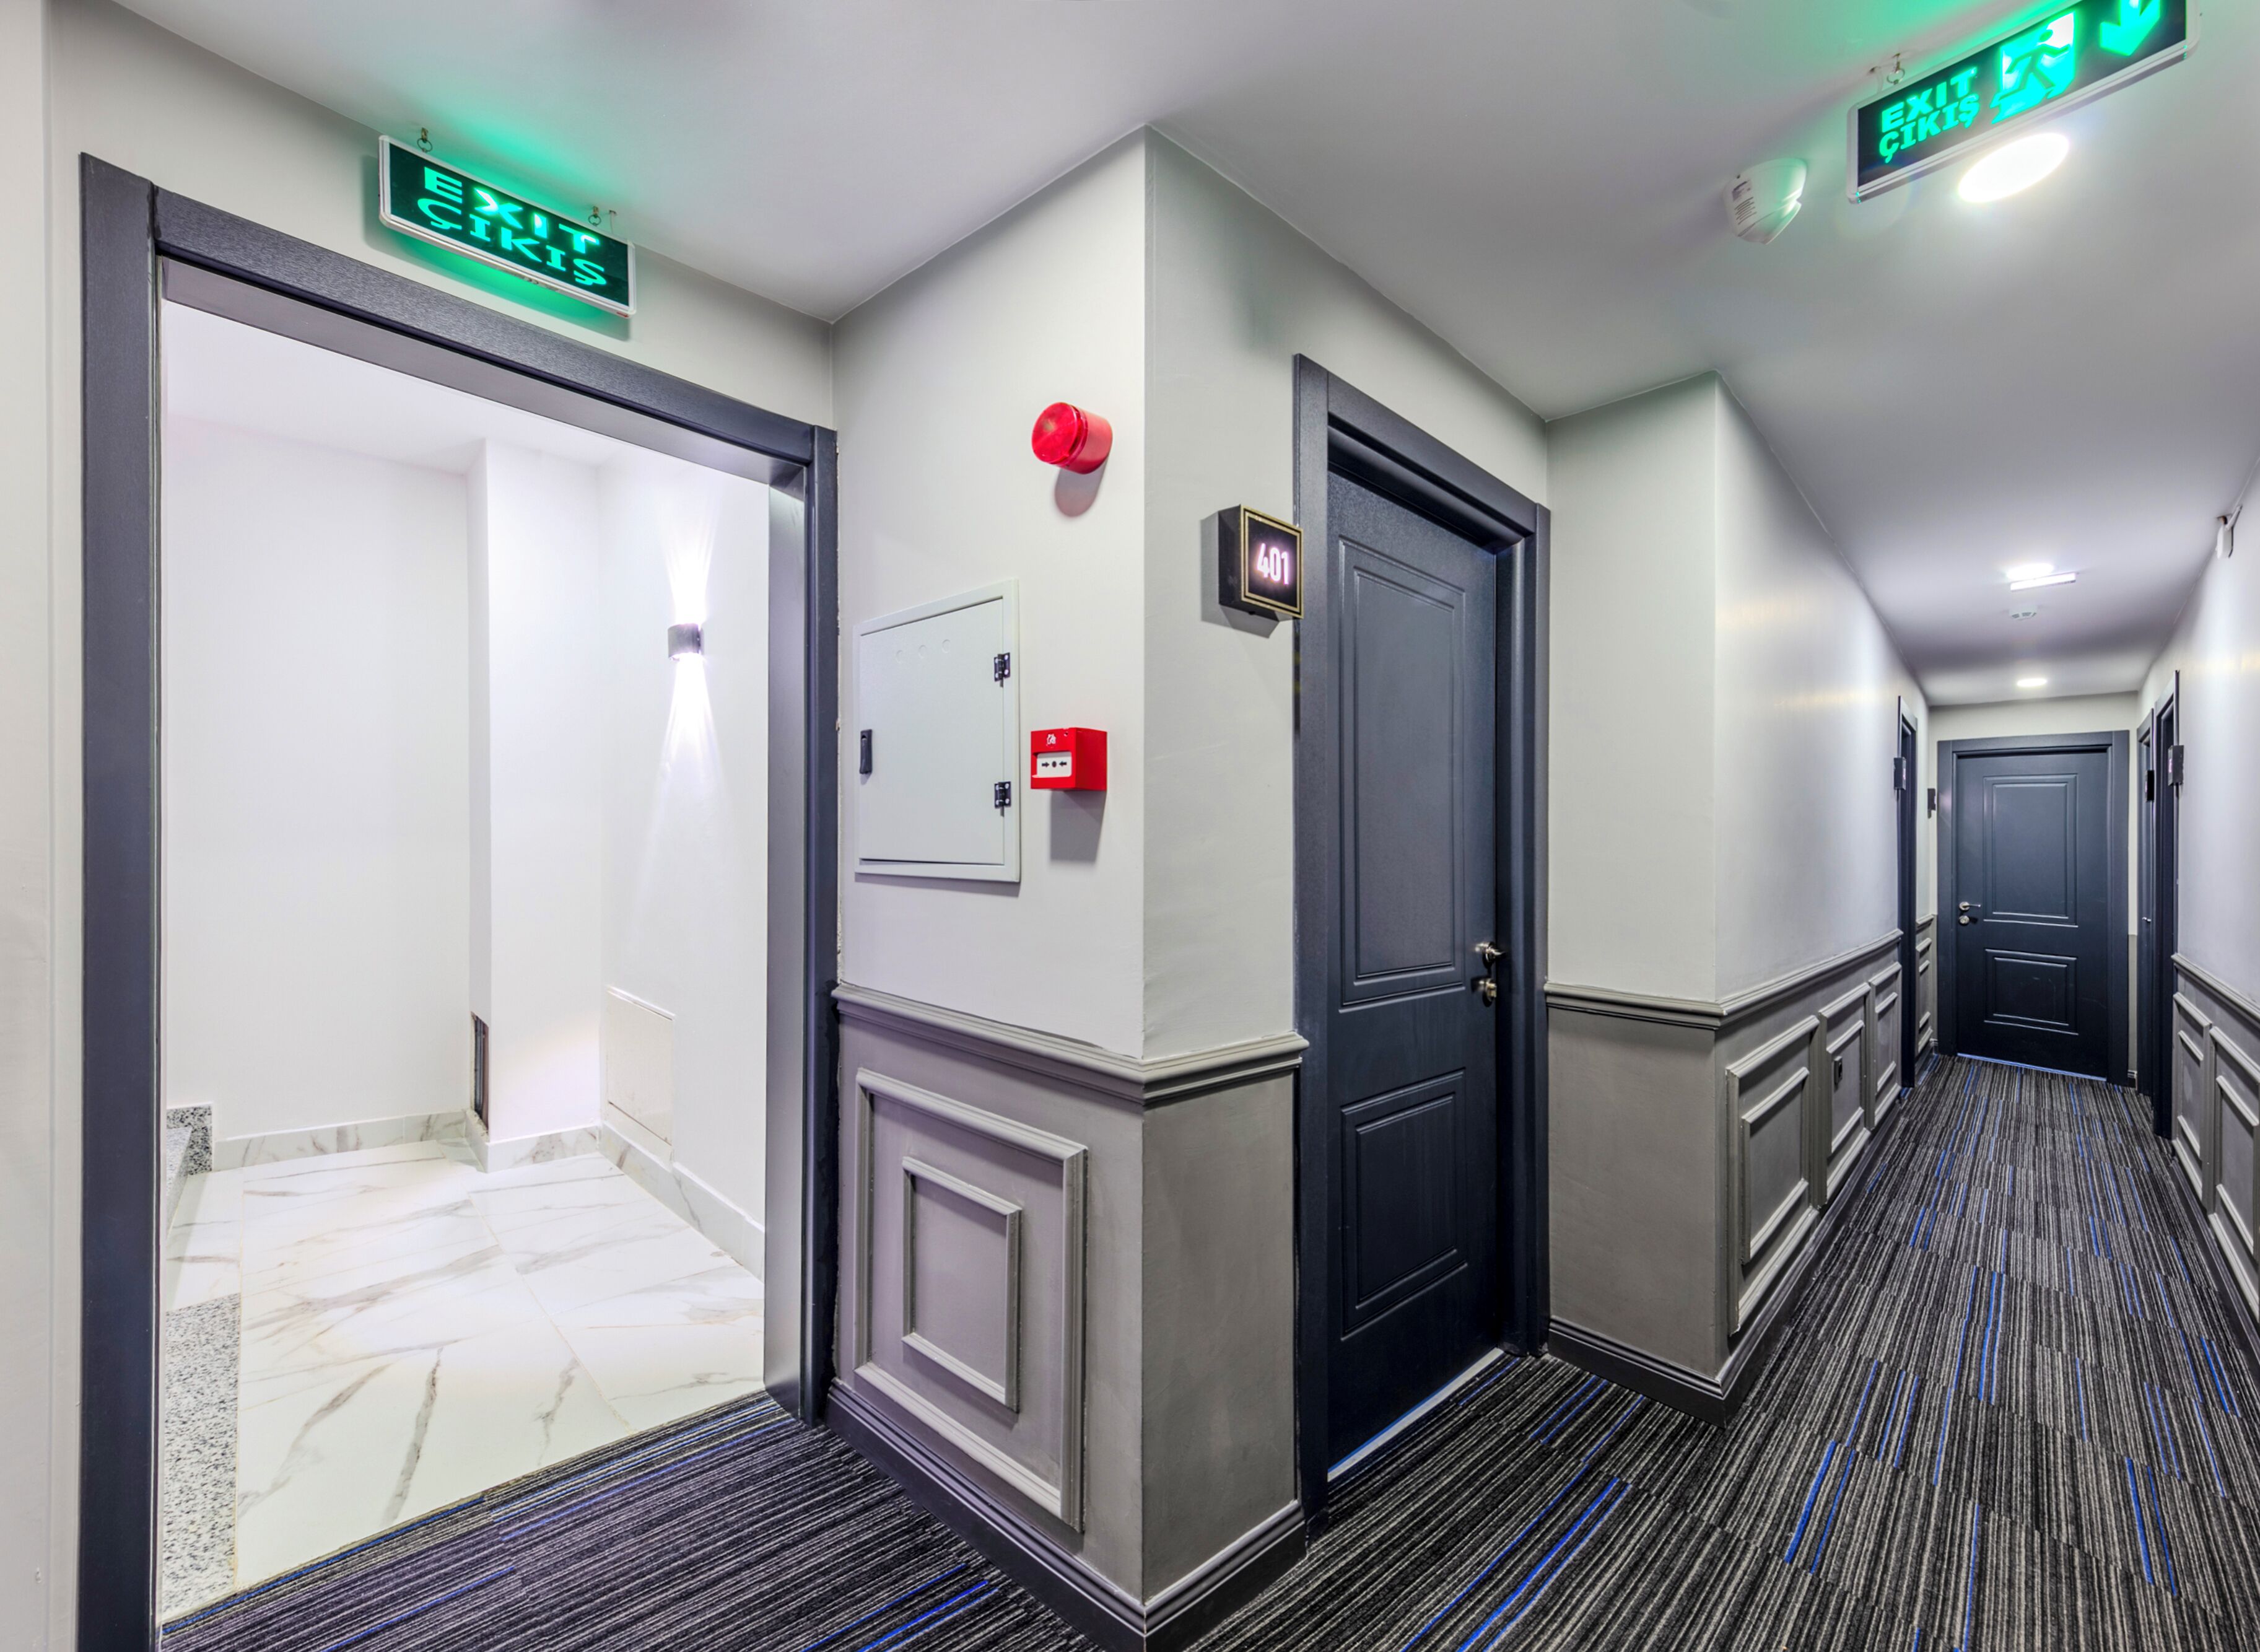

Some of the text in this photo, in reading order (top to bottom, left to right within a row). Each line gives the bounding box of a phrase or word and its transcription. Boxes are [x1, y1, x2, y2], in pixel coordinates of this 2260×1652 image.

[1878, 94, 1979, 163] ÇIKIŞ
[1881, 67, 1977, 132] EXIT
[417, 198, 607, 286] ÇIKIŞ
[424, 167, 600, 254] EXIT
[1257, 543, 1289, 585] 401
